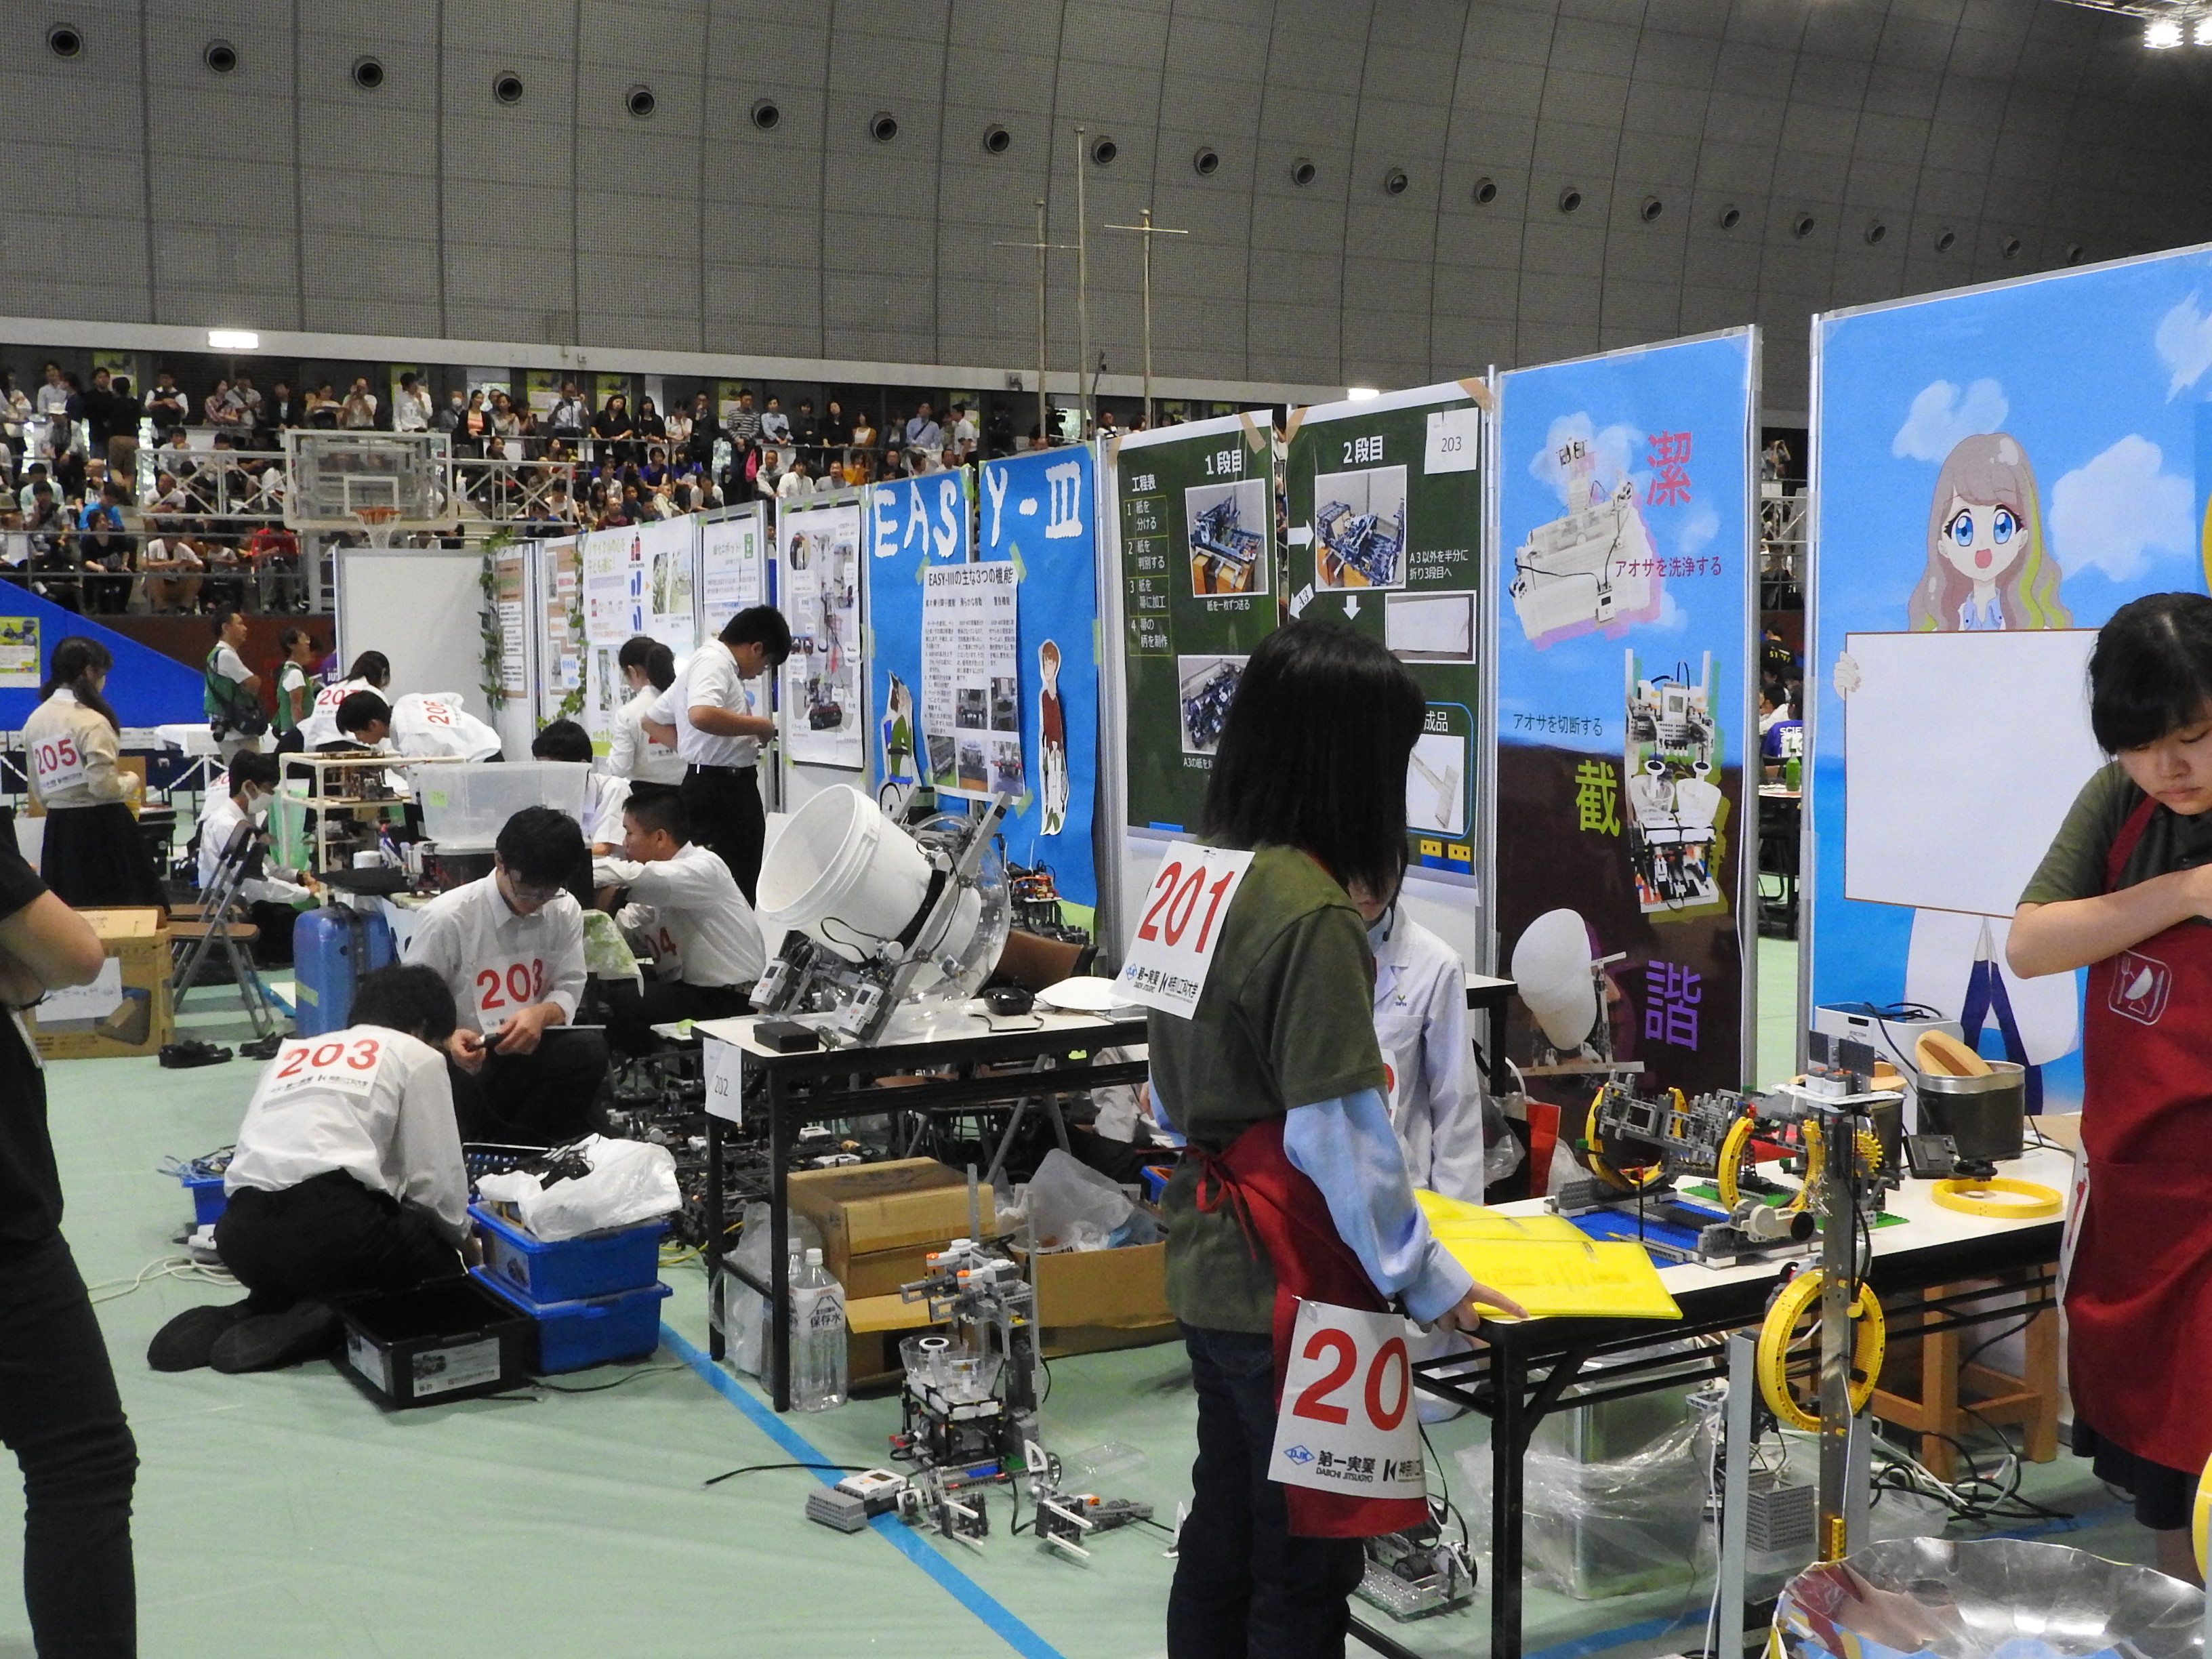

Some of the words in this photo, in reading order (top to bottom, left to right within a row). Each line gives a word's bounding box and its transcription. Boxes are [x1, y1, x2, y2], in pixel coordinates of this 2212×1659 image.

[1343, 435, 1383, 464] 2段目
[1441, 437, 1462, 453] 203
[1205, 449, 1242, 475] 1段目
[1647, 430, 1691, 506] 潔
[1132, 474, 1156, 492] 工程表
[1136, 516, 1157, 531] 分ける
[1616, 556, 1721, 577] アオサを洗浄する
[1514, 714, 1603, 737] アオサを切断する
[35, 739, 77, 775] 205
[1575, 759, 1620, 837] 截
[1138, 861, 1235, 954] 201
[476, 958, 543, 1010] 203
[1645, 960, 1702, 1051] 諧
[276, 1039, 380, 1079] 203
[715, 1075, 728, 1097] 202
[1317, 1450, 1376, 1474] 第一実業
